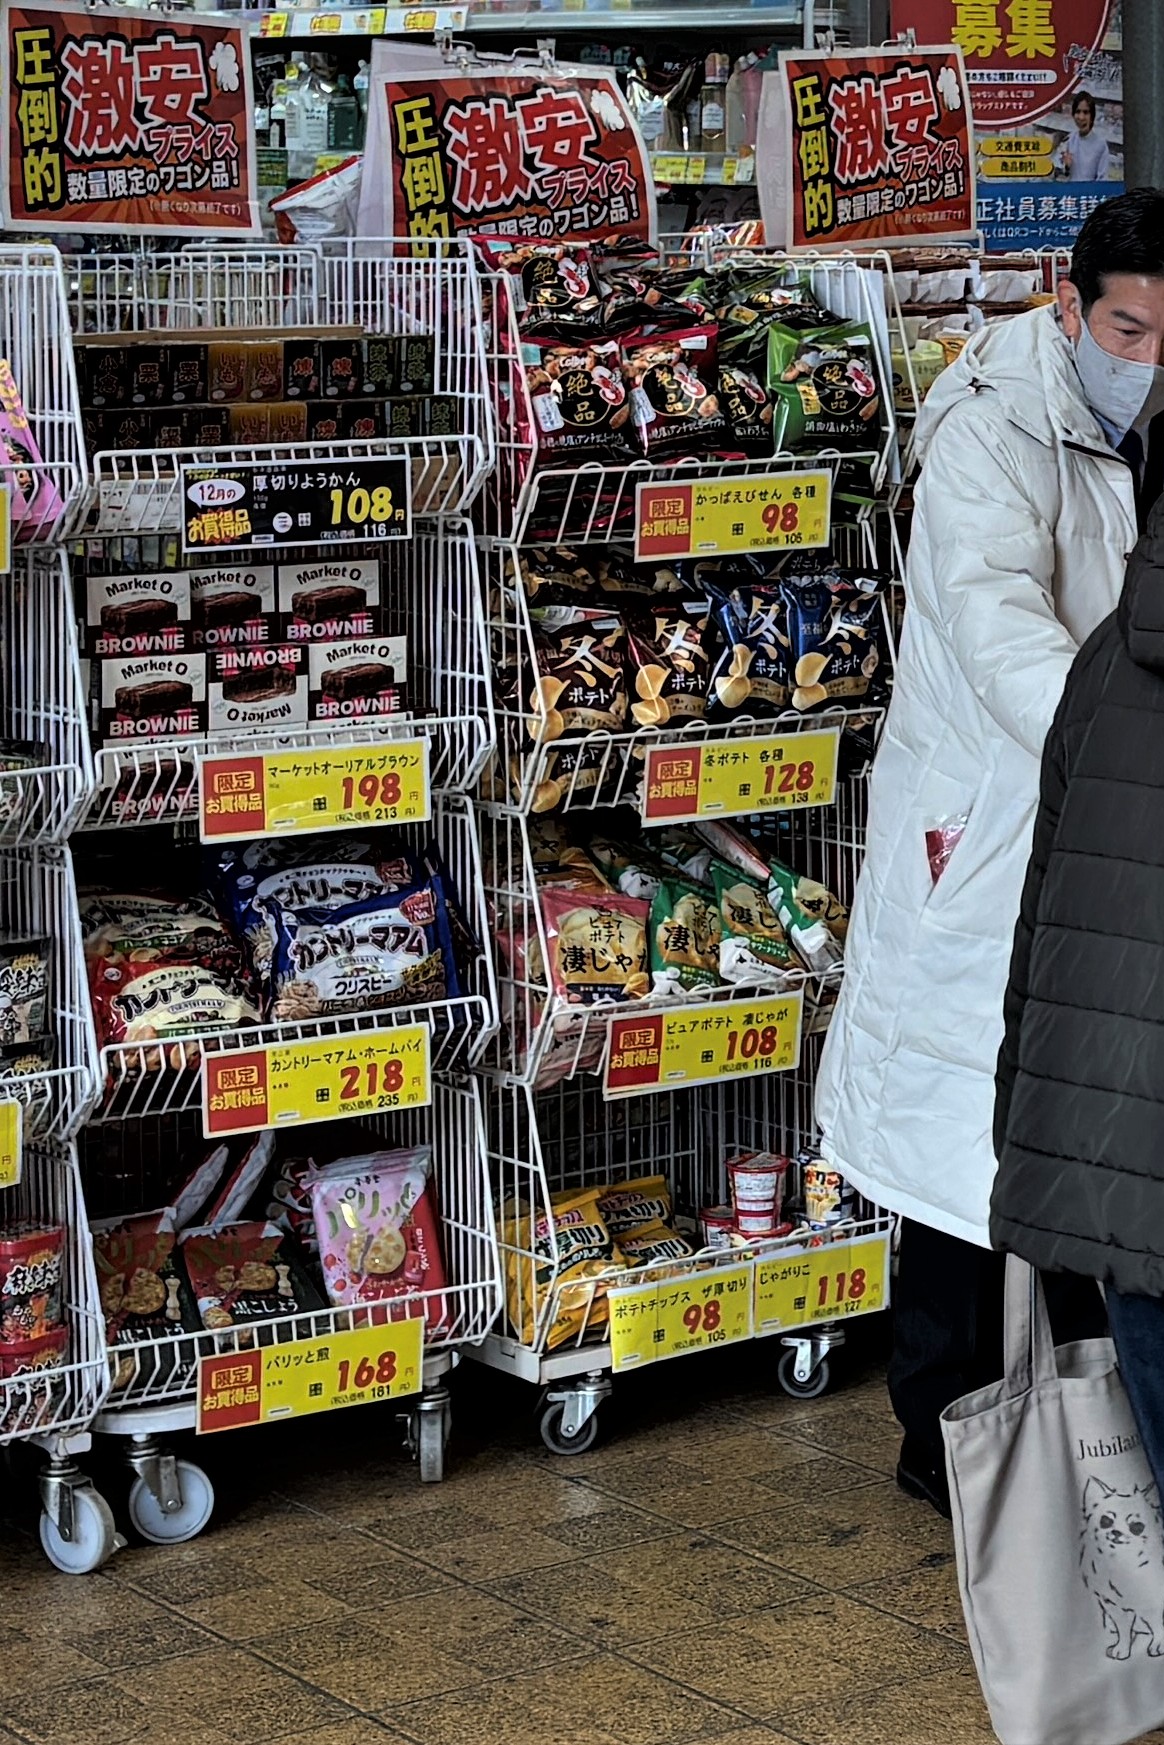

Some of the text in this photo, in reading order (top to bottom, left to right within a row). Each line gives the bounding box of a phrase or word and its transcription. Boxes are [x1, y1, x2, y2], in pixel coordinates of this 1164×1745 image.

[951, 0, 1056, 58] 募集
[62, 35, 208, 157] 激安
[15, 29, 62, 205] 圧倒的
[828, 67, 939, 184] 激安
[150, 123, 239, 164] プライス
[443, 87, 602, 214] 激安
[793, 75, 833, 231] 圧倒的
[896, 139, 963, 182] プライス
[67, 160, 239, 202] 数量限定のワゴン品!
[393, 96, 450, 259] 圧倒的
[542, 160, 637, 210] プライス
[977, 195, 1106, 222] 正社員募集詳
[566, 372, 595, 422] 絶品
[822, 364, 849, 410] 絶品
[198, 484, 236, 501] 12月の
[253, 472, 361, 492] 厚切りようかん
[331, 487, 404, 525] 108 円
[695, 486, 816, 506] かっぱえびせん 各種
[652, 501, 682, 516] 限定
[762, 502, 798, 533] 98
[187, 508, 252, 543] お買得品
[363, 524, 387, 538] 116
[641, 519, 689, 537] お買得品
[190, 570, 256, 591] Market O
[297, 566, 362, 585] Market O
[105, 577, 173, 598] Market O
[193, 626, 269, 645] ROWNIE
[286, 619, 374, 640] BROWNIE
[745, 596, 790, 661] 冬
[818, 595, 868, 656] 冬
[95, 633, 185, 654] BROWNIE
[326, 643, 390, 663] Market O
[654, 617, 709, 673] 冬
[216, 648, 301, 670] BROWNIE
[553, 635, 619, 687] 冬
[756, 658, 787, 678] ポテト
[832, 655, 860, 675] ポテト
[121, 660, 188, 680] Market O
[672, 674, 706, 691] ポテト
[569, 687, 610, 704] ポテト
[227, 703, 292, 723] Market O
[315, 696, 400, 718] BROWNIE
[109, 715, 200, 736] BROWNIE
[704, 751, 750, 767] 冬ポテト
[218, 774, 252, 792] 限定
[764, 761, 814, 794] 128
[342, 773, 401, 809] 198
[649, 780, 697, 798] お買得品
[206, 795, 262, 814] お買得品
[375, 807, 397, 819] 213
[589, 916, 623, 928] ピュア
[589, 930, 625, 943] ポテト
[334, 977, 393, 997] クリスピー
[666, 1016, 733, 1035] ピュアポテト
[727, 1026, 777, 1060] 108
[611, 1048, 659, 1069] お買得品
[754, 1057, 772, 1069] 116
[220, 1068, 255, 1087] 限定
[340, 1059, 404, 1100] 218
[209, 1088, 266, 1111] お買得品
[377, 1093, 399, 1108] 235
[760, 1265, 810, 1284] じゃがりこ
[818, 1268, 866, 1305] 118
[615, 1277, 747, 1319] ポテトチップス ザ厚切り
[683, 1299, 721, 1334] 98
[707, 1330, 726, 1343] 105
[215, 1368, 249, 1388] 限定
[339, 1351, 397, 1392] 168
[203, 1385, 259, 1411] お買得品
[371, 1385, 391, 1398] 181
